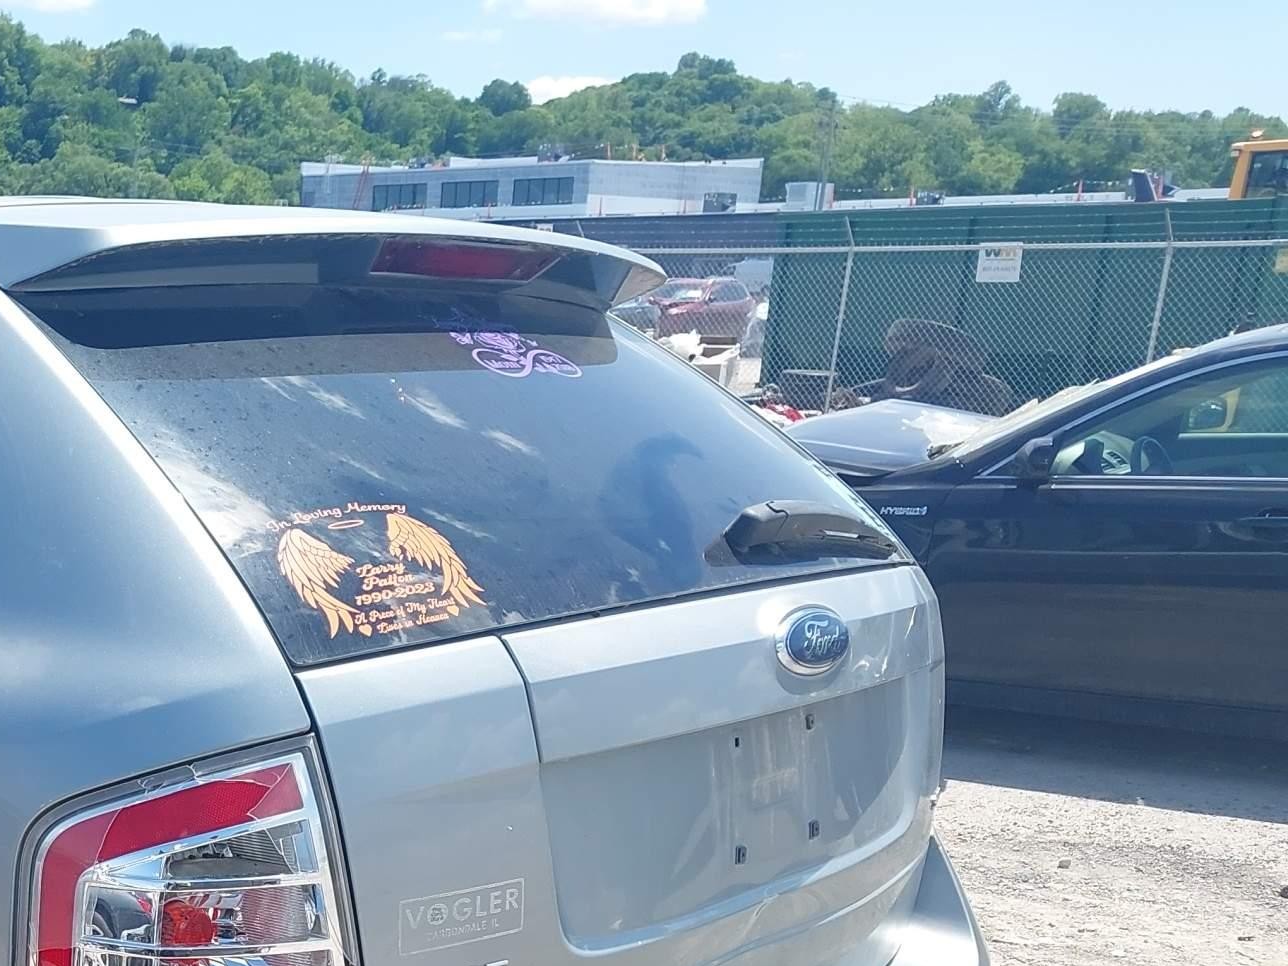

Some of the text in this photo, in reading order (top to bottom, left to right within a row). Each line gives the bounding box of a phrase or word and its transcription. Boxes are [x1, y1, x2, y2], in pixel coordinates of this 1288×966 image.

[266, 502, 406, 532] In Loving Memory
[879, 506, 921, 515] HYBRID
[356, 562, 405, 578] Larry
[405, 602, 427, 613] My
[803, 620, 841, 659] Ford
[405, 888, 520, 930] VOGLER
